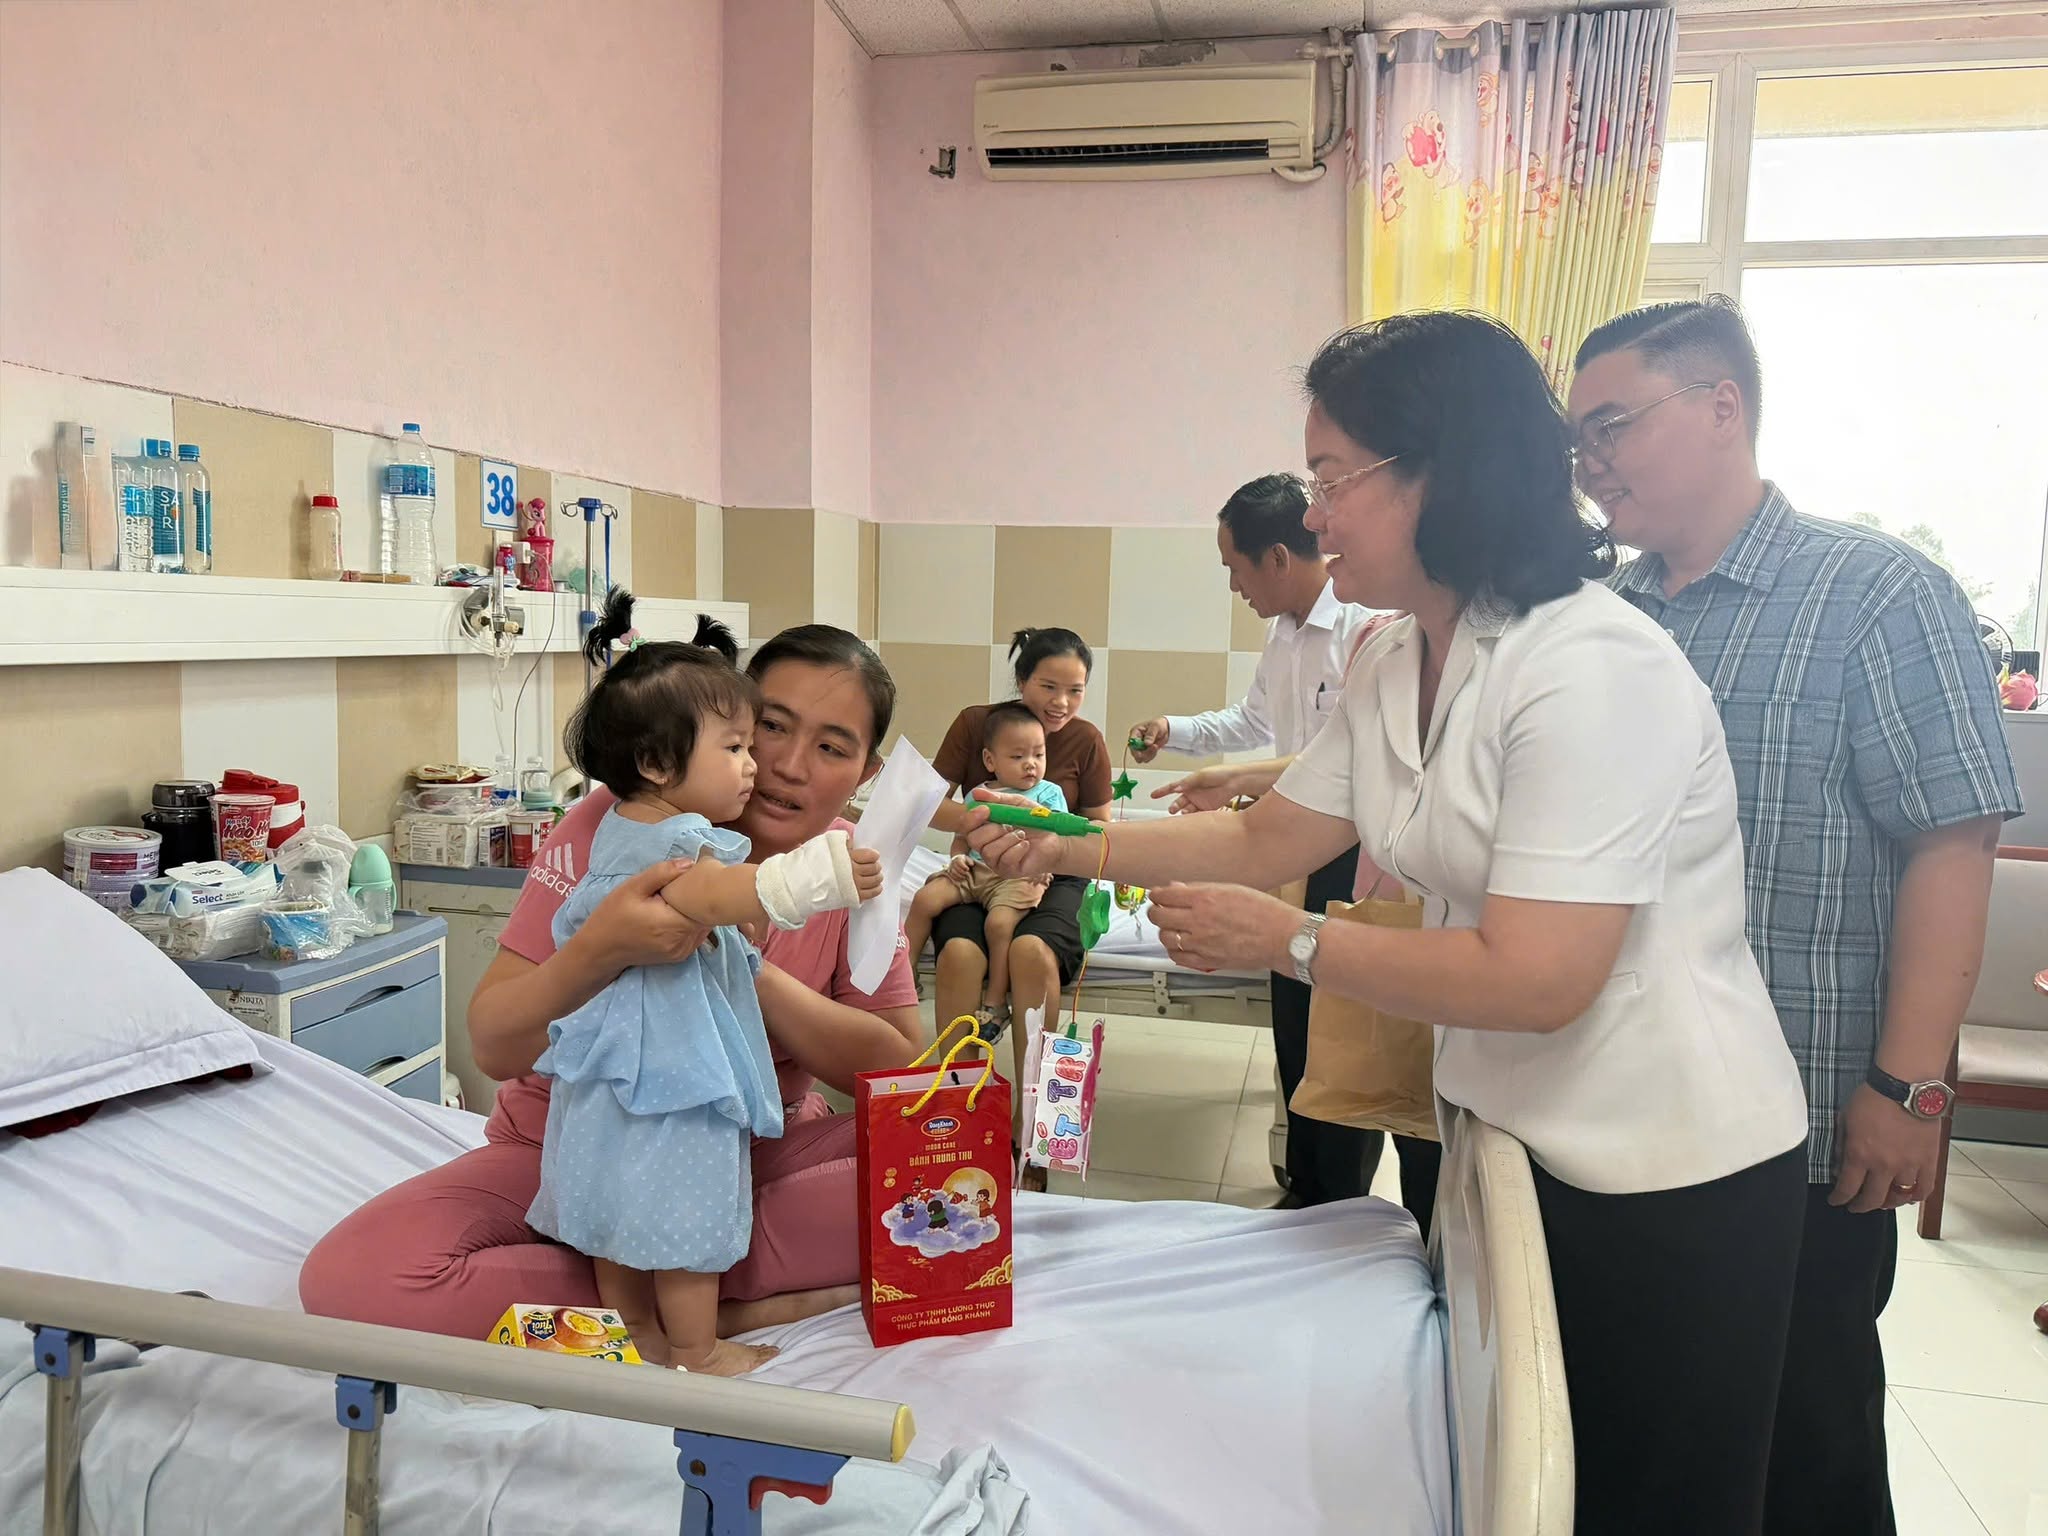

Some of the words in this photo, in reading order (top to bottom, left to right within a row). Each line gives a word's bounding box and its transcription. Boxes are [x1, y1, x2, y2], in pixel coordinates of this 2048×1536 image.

[487, 472, 515, 517] 38
[531, 865, 576, 897] adidas
[192, 893, 223, 904] Select
[909, 1154, 930, 1167] BÁNH
[932, 1152, 956, 1164] TRUNG
[958, 1150, 973, 1161] THU
[891, 1313, 913, 1323] CÔNG
[915, 1311, 924, 1319] TY
[926, 1308, 947, 1317] TNHH
[948, 1304, 974, 1314] LƯƠNG
[975, 1301, 996, 1310] THỰC
[896, 1321, 918, 1330] THỰC
[918, 1316, 940, 1327] PHẨM
[941, 1314, 963, 1324] ĐỒNG
[964, 1308, 991, 1320] KHÁNH
